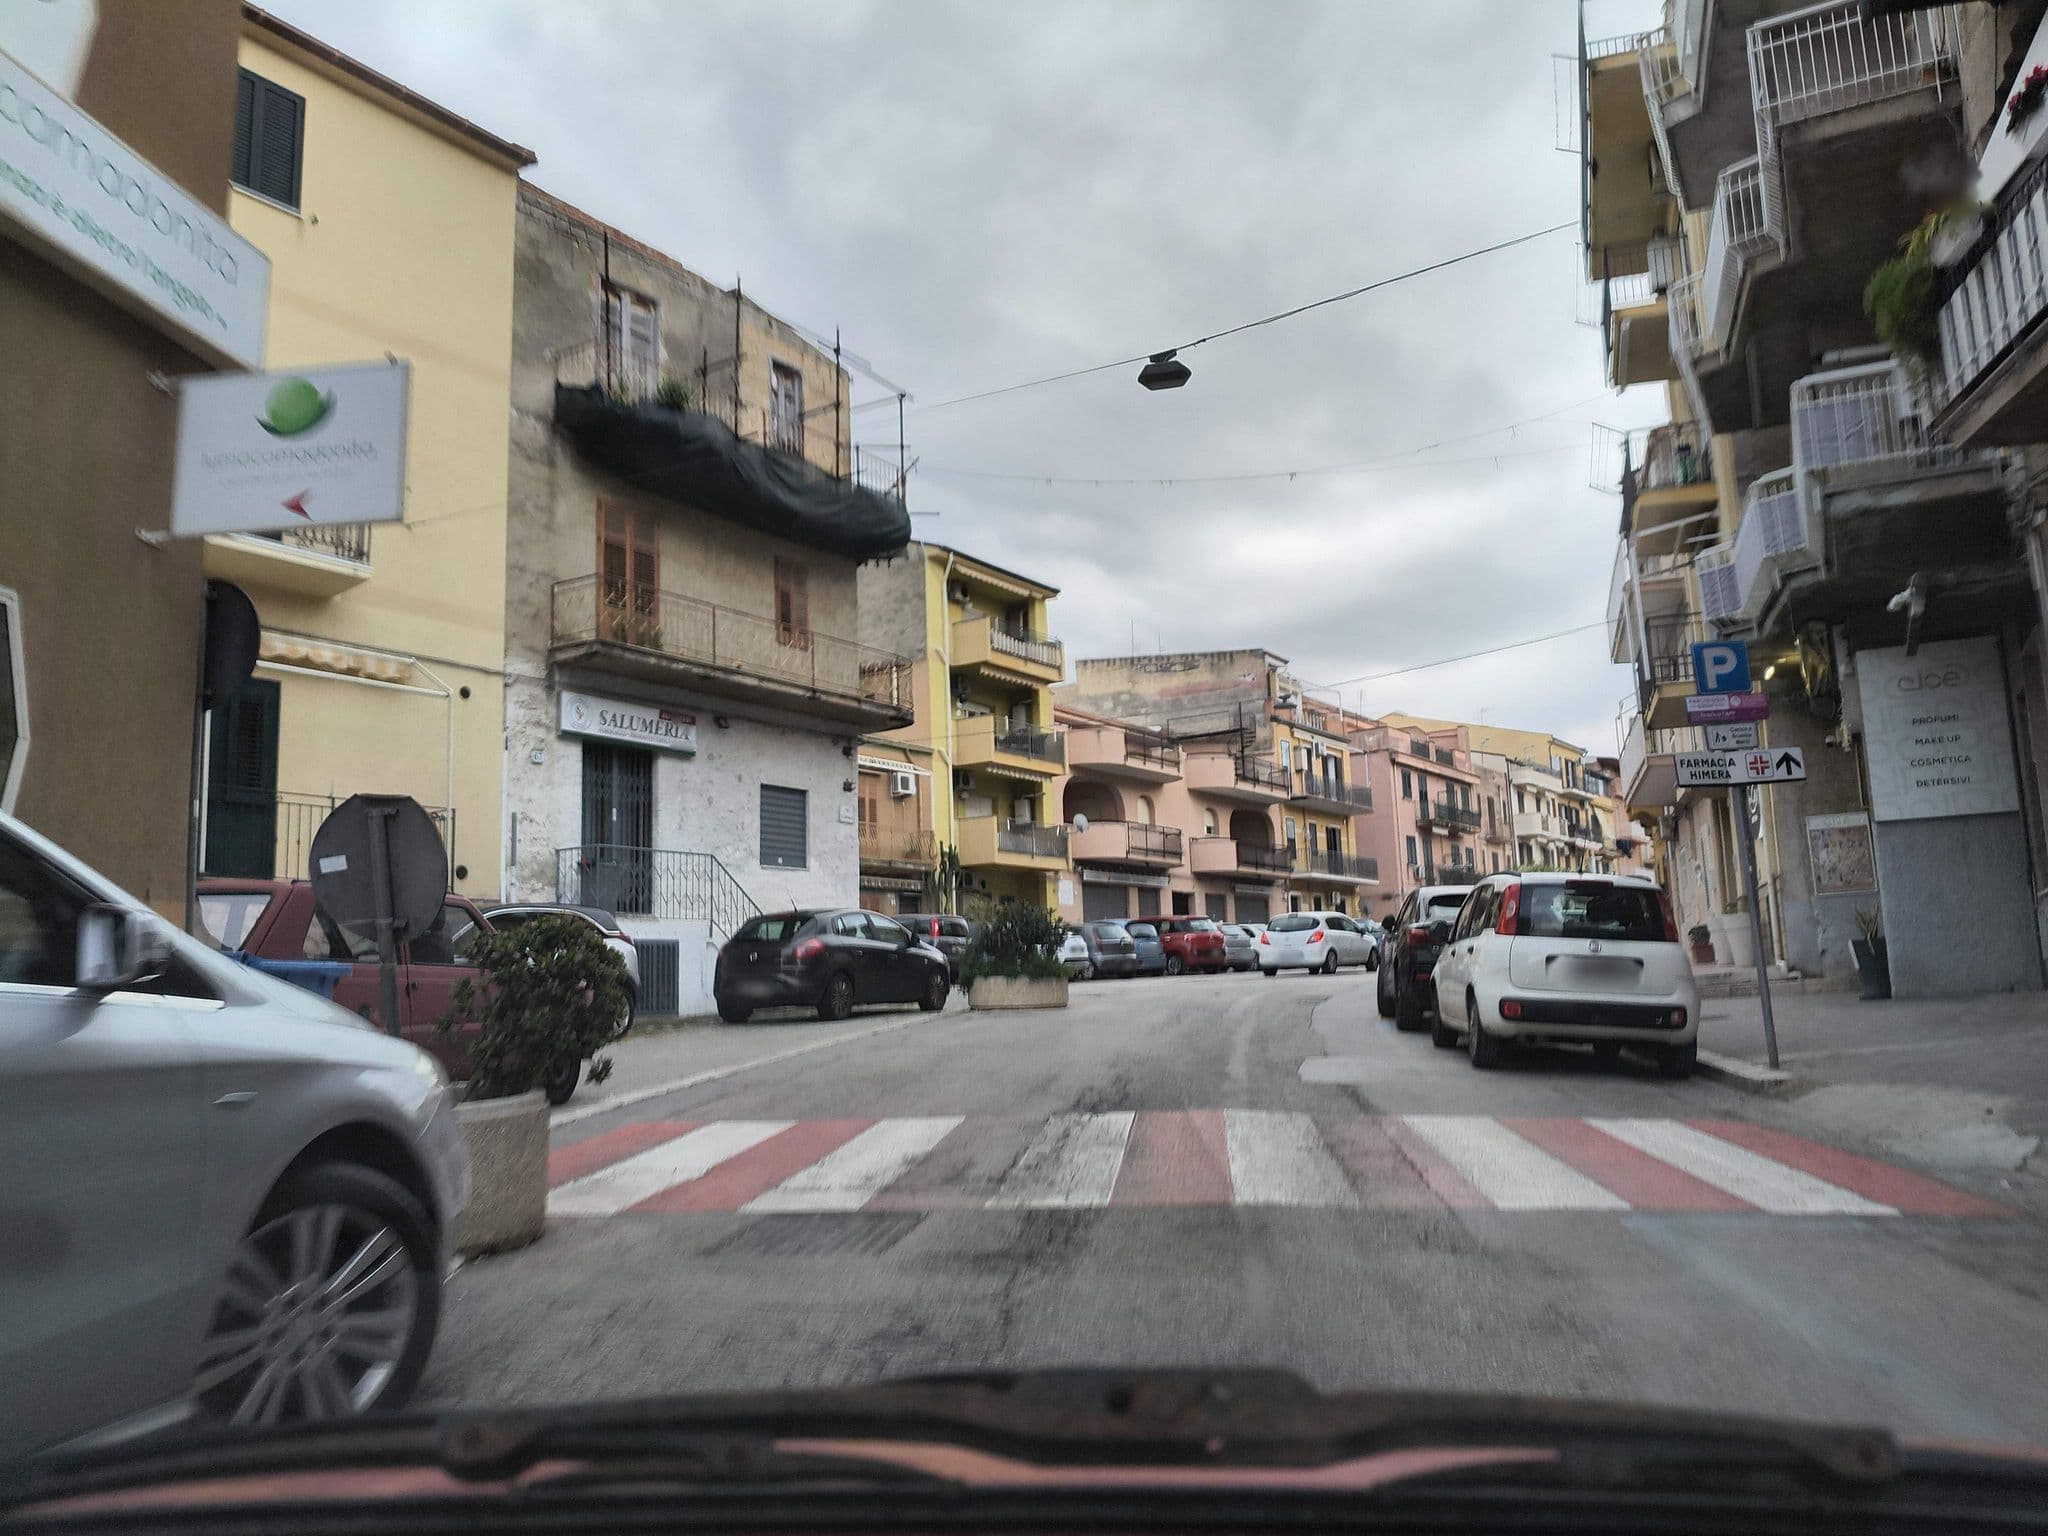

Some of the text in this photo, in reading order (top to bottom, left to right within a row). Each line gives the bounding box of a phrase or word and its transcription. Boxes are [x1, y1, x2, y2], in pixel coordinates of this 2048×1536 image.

[1702, 646, 1738, 689] P
[599, 709, 690, 740] SALUMERIA
[1911, 714, 1960, 725] PROFUMI
[1915, 735, 1961, 746] MAKE UP
[1679, 757, 1736, 769] FARMACIA
[1910, 755, 1972, 767] COSMETICA
[1690, 770, 1732, 780] HIMERA
[1915, 777, 1971, 788] DETERSIVI
